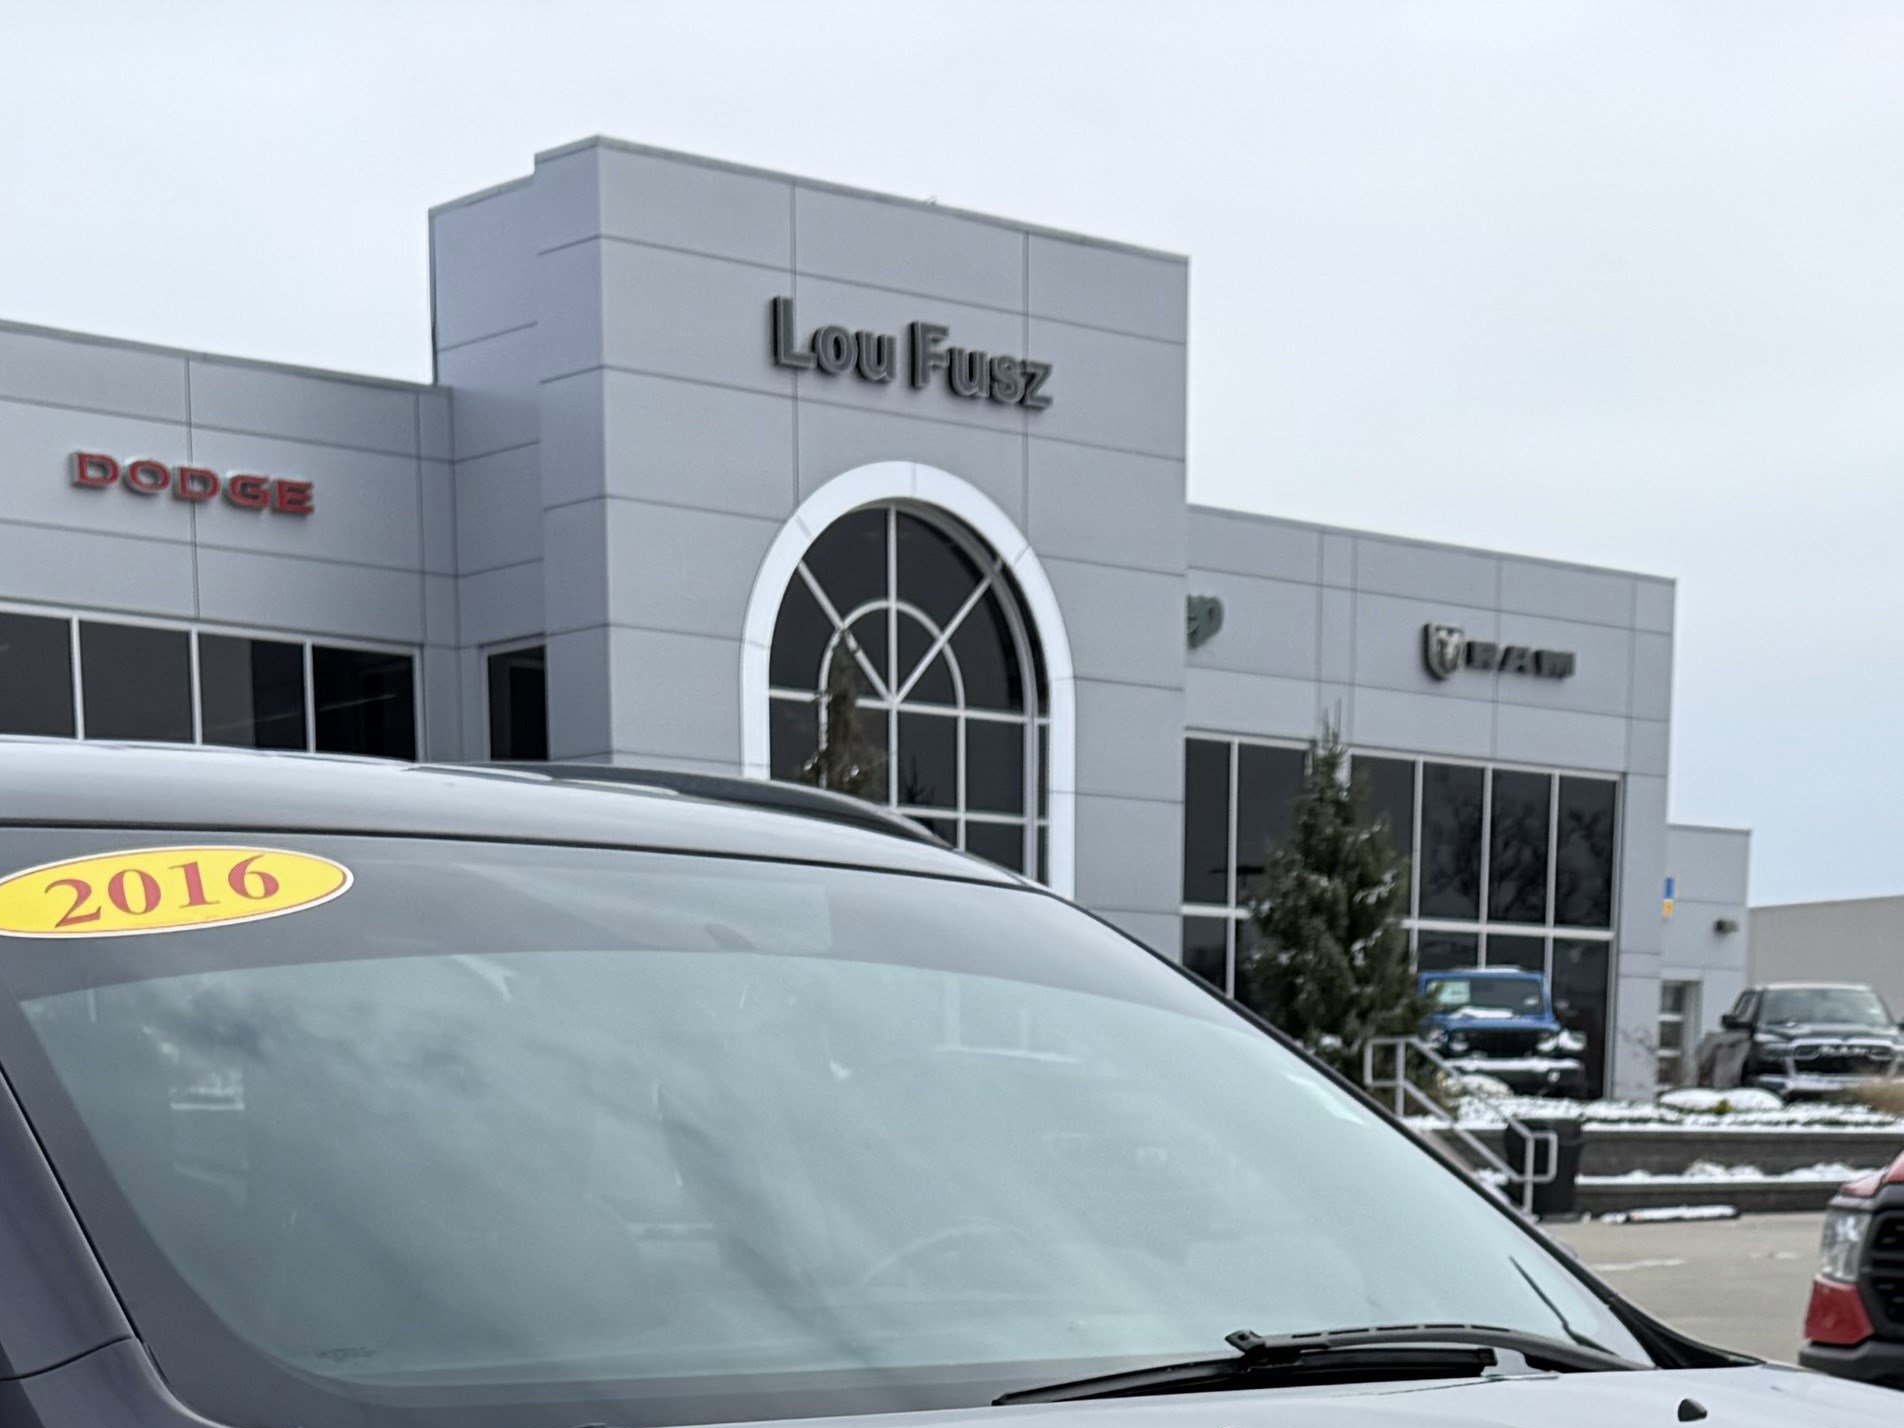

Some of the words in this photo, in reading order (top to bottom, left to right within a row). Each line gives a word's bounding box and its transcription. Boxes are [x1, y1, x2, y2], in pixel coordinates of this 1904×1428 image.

[771, 295, 894, 386] Lou
[909, 320, 1054, 410] Fusz
[70, 450, 314, 515] DODGE
[1465, 641, 1576, 680] RAM
[44, 854, 280, 928] 2016
